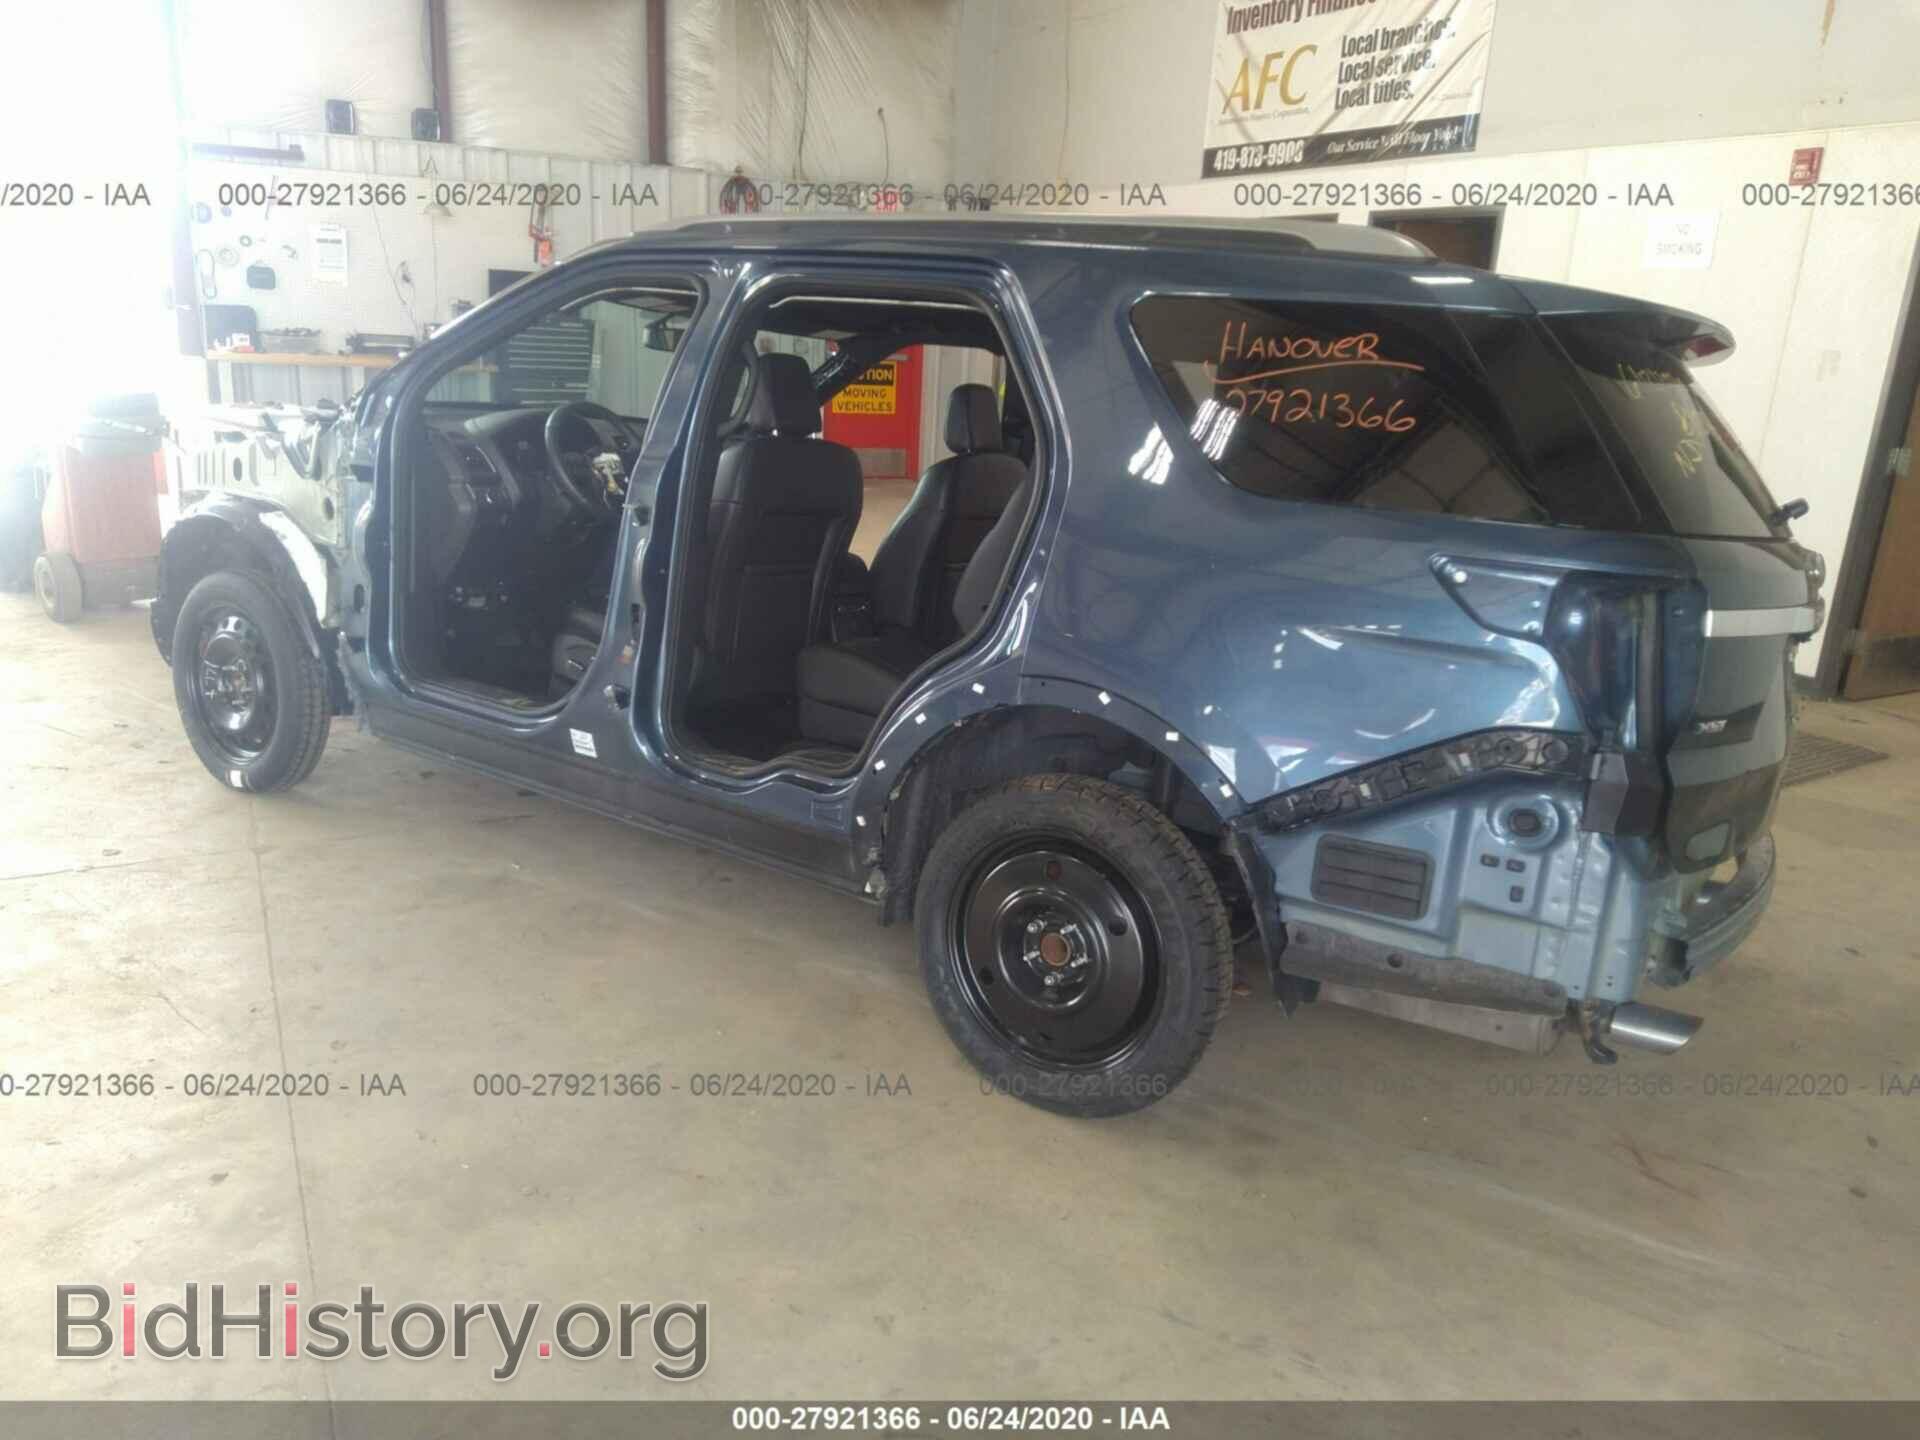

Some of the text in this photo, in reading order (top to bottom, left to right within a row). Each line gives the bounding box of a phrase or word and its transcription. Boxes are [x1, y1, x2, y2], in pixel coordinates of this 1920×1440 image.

[1227, 0, 1304, 34] Inventory
[1341, 28, 1379, 58] Local
[1222, 45, 1319, 114] AFC
[1338, 56, 1376, 84] Local
[1335, 80, 1414, 110] Local titles.
[836, 399, 893, 411] VEHICLES
[842, 387, 887, 399] MOVING
[1225, 387, 1417, 432] 27921366
